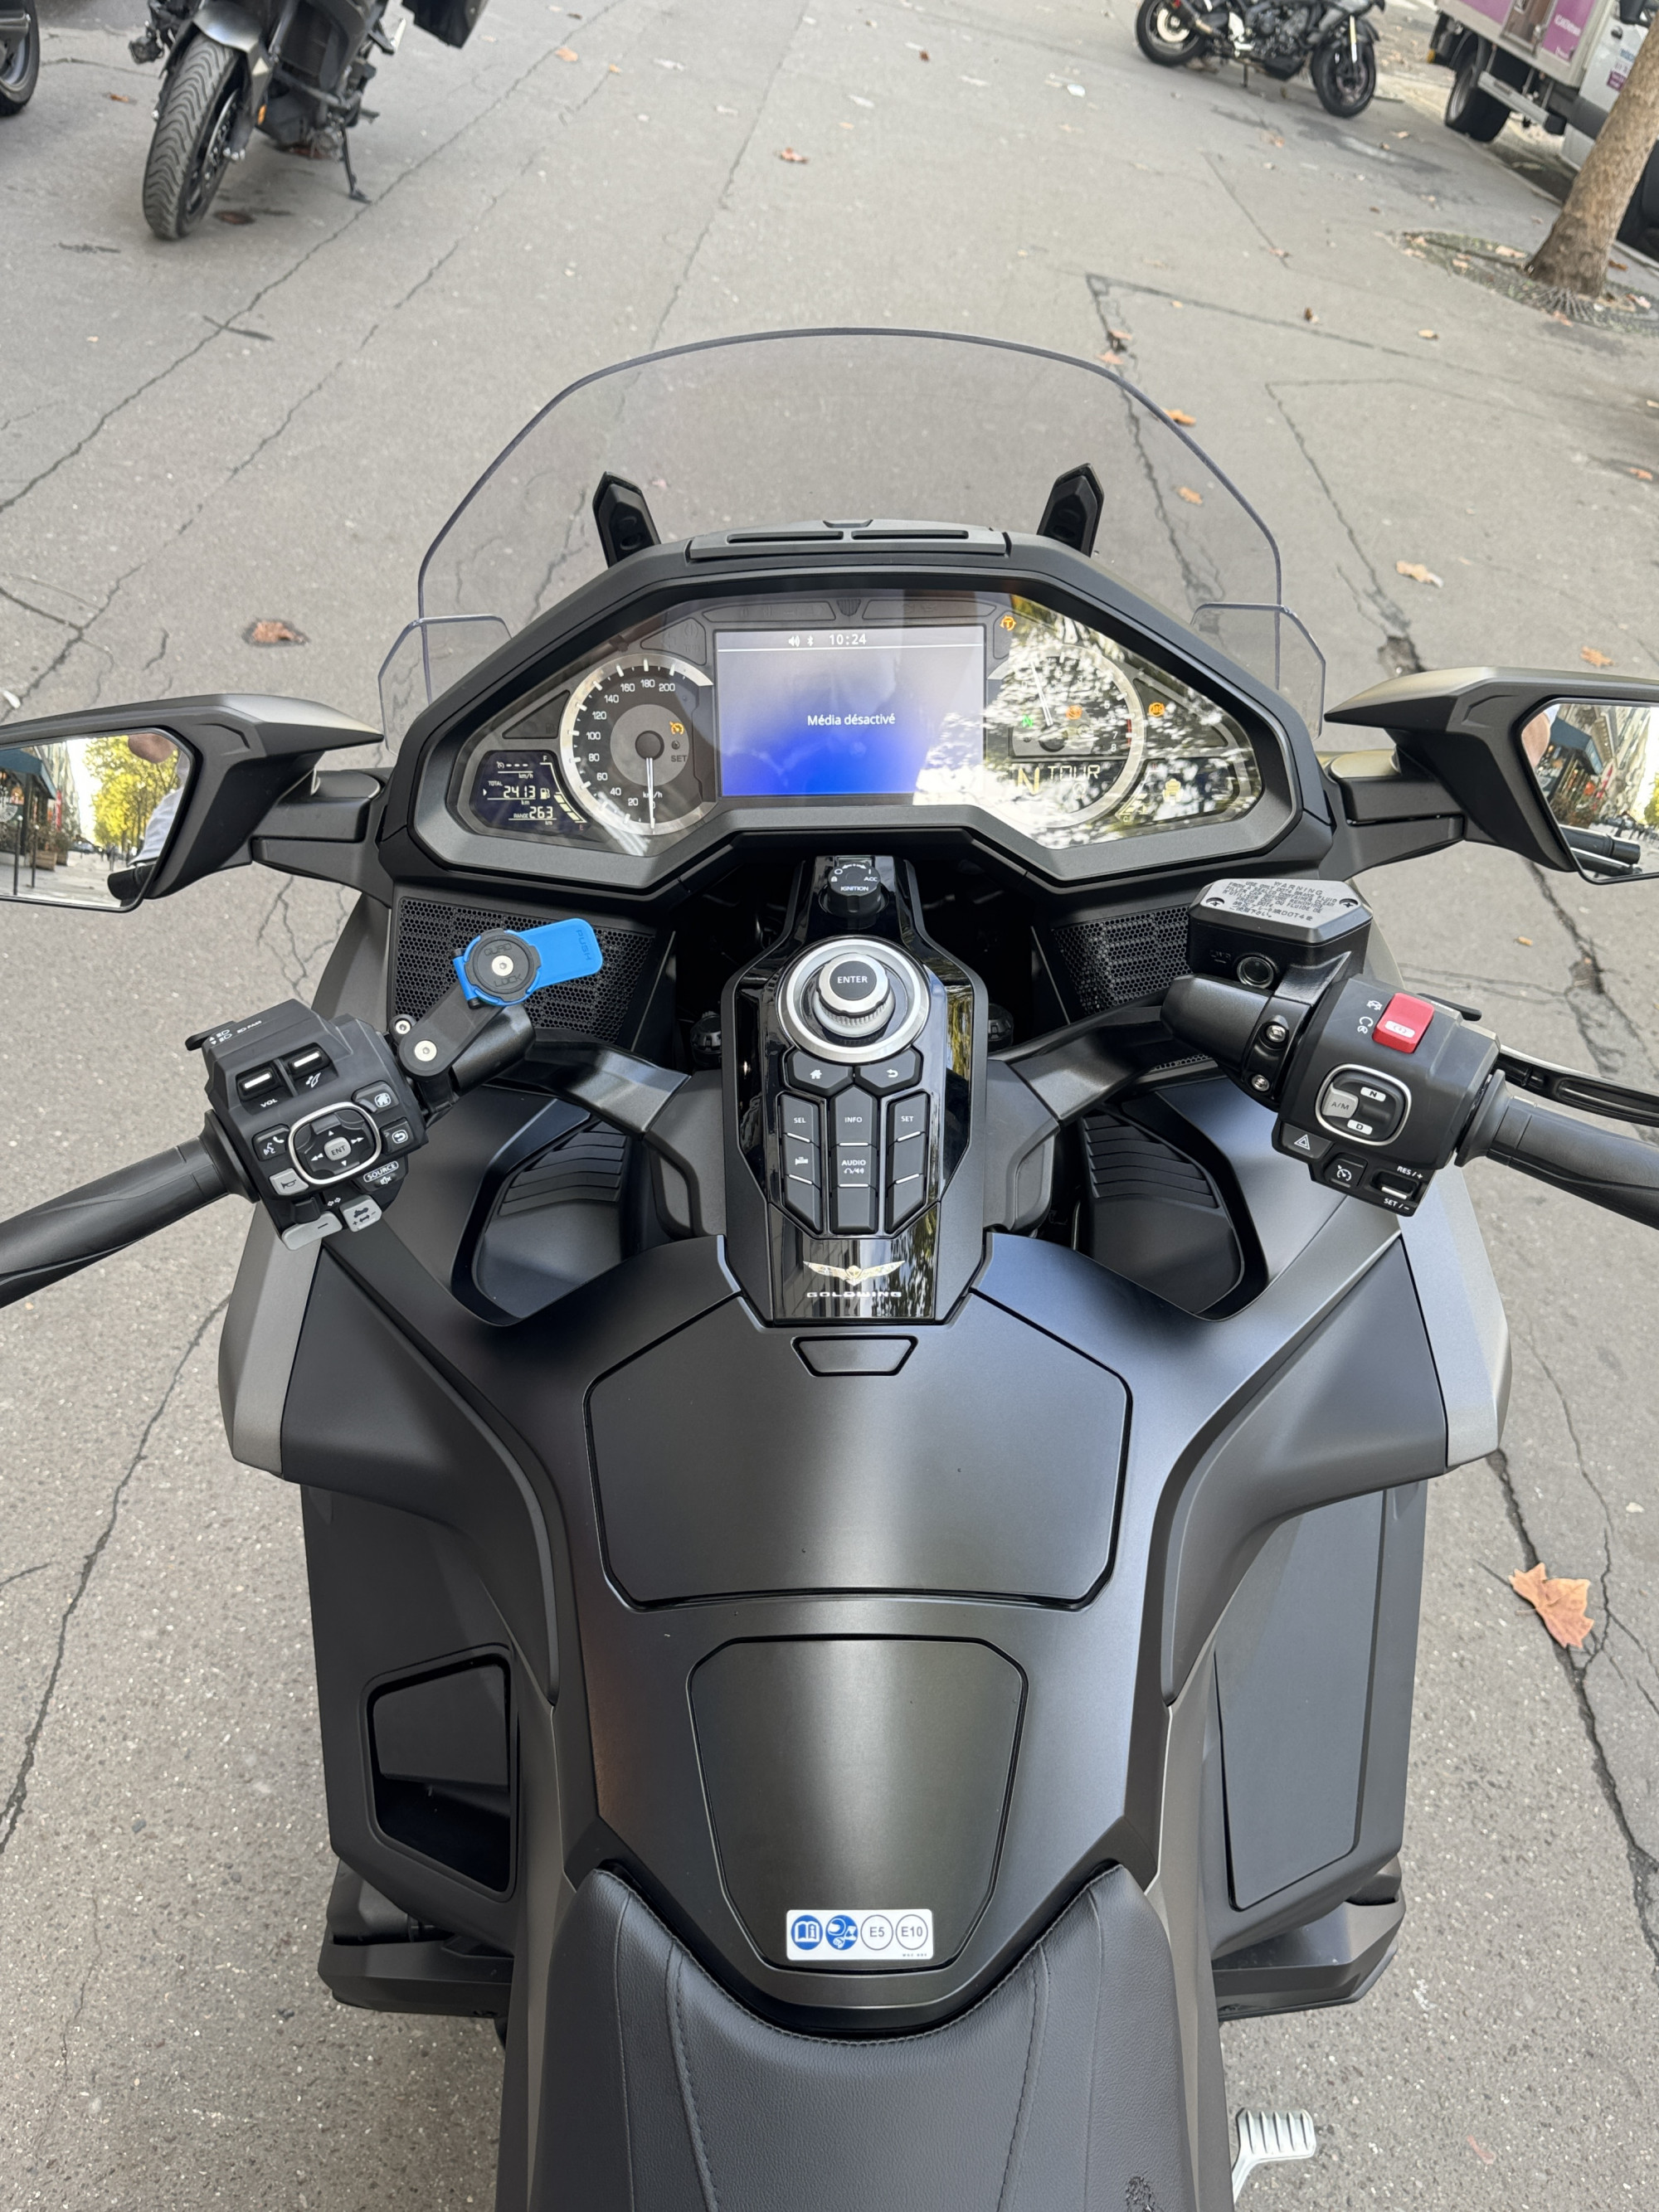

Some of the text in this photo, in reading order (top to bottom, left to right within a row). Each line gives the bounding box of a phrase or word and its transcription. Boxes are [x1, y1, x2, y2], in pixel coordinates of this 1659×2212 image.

[829, 633, 867, 645] 10:24
[620, 683, 635, 693] 160
[640, 679, 655, 688] 180
[659, 683, 676, 692] 200
[604, 694, 620, 703] 140
[592, 711, 607, 720] 120
[808, 713, 895, 726] Média désactivé
[586, 732, 601, 740] 100
[1112, 731, 1118, 739] 7
[1111, 744, 1117, 752] 8
[589, 753, 600, 762] 80
[597, 773, 608, 781] 60
[1018, 765, 1100, 795] N TOUR
[504, 785, 536, 798] 2413
[610, 788, 622, 796] 40
[628, 798, 638, 806] 20
[529, 806, 553, 819] 263
[1273, 880, 1322, 895] WARNING
[576, 929, 592, 960] PUSH
[484, 943, 512, 956] QUAD
[494, 974, 523, 987] LOCK
[837, 975, 868, 984] ENTER
[260, 1099, 278, 1107] VOL
[1331, 1101, 1350, 1110] A/M
[331, 1145, 346, 1155] ENT
[367, 1162, 396, 1180] SOURCE
[870, 1926, 923, 1937] E5 E10
